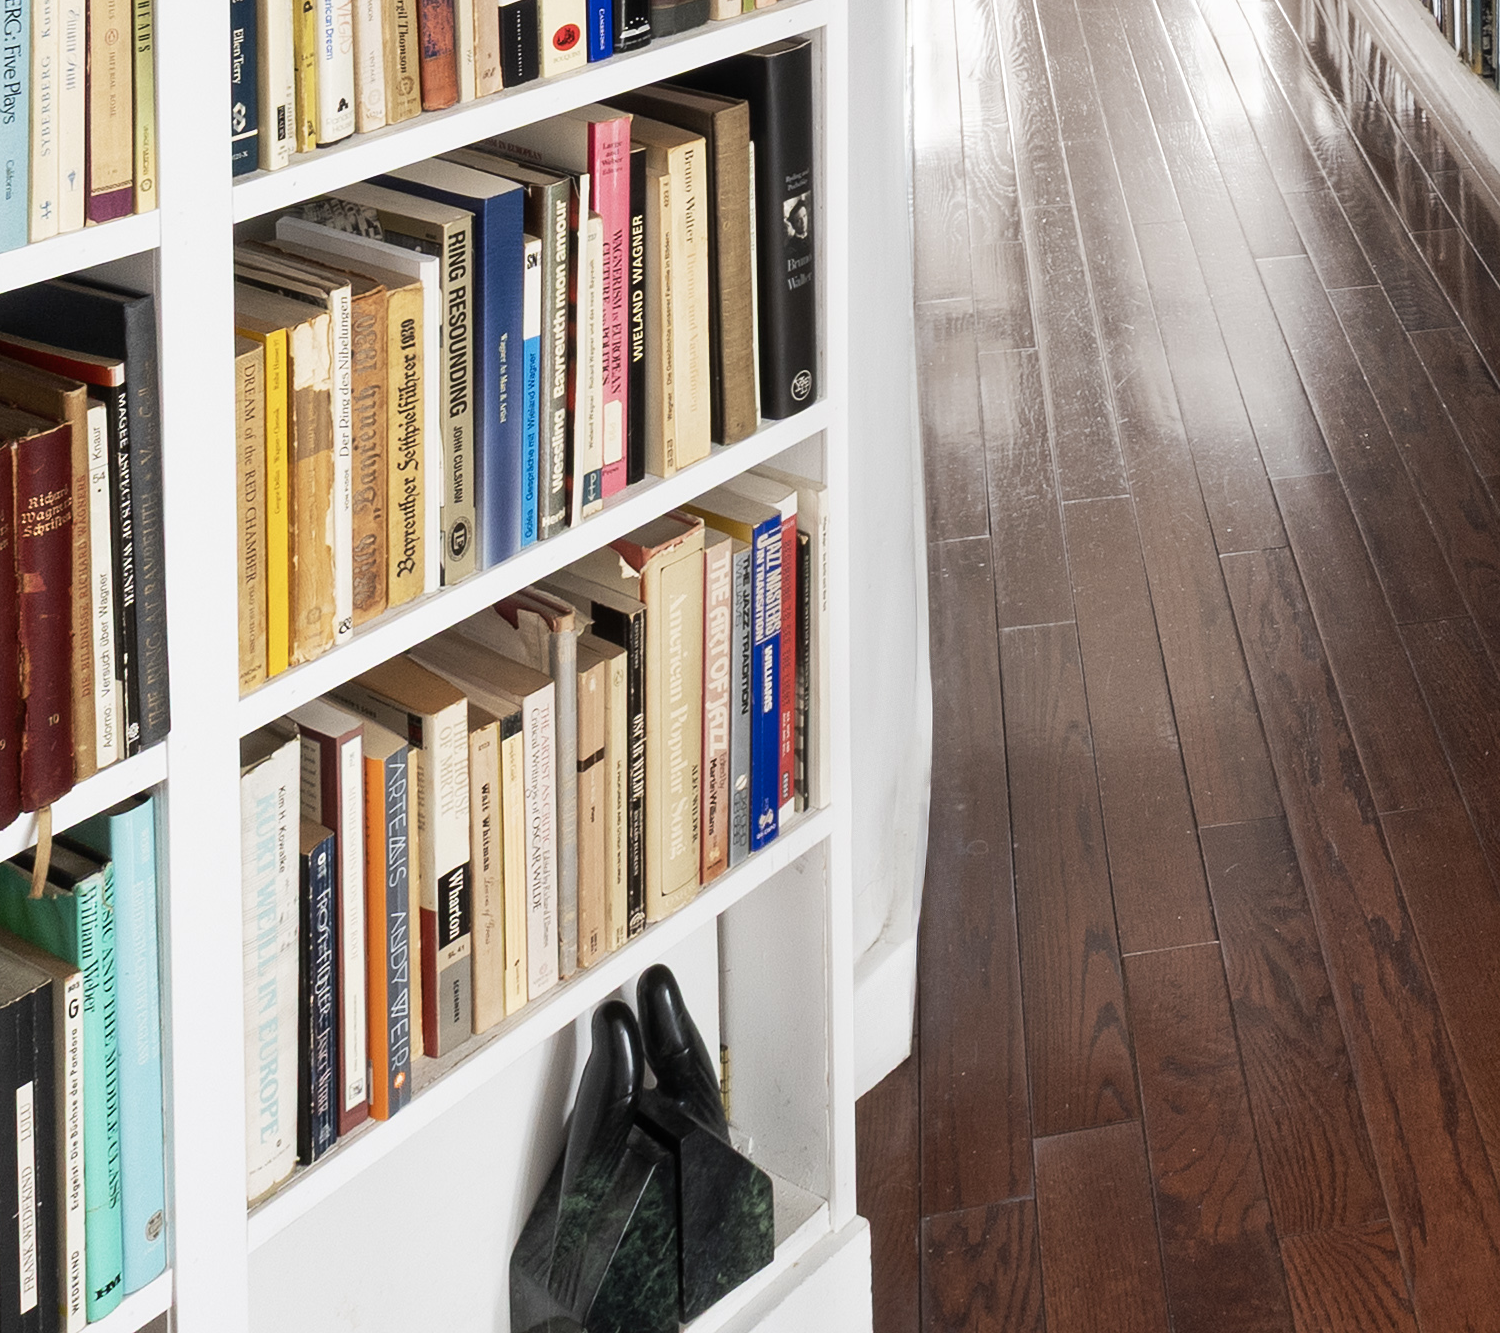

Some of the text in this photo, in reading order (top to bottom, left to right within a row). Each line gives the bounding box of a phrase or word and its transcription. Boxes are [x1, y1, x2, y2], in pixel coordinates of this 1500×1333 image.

[2, 42, 21, 78] Five
[2, 82, 19, 125] Plays
[449, 229, 469, 417] RING RESOUNDING
[632, 213, 643, 361] WIELAND WAGNER
[448, 869, 463, 941] Wharton
